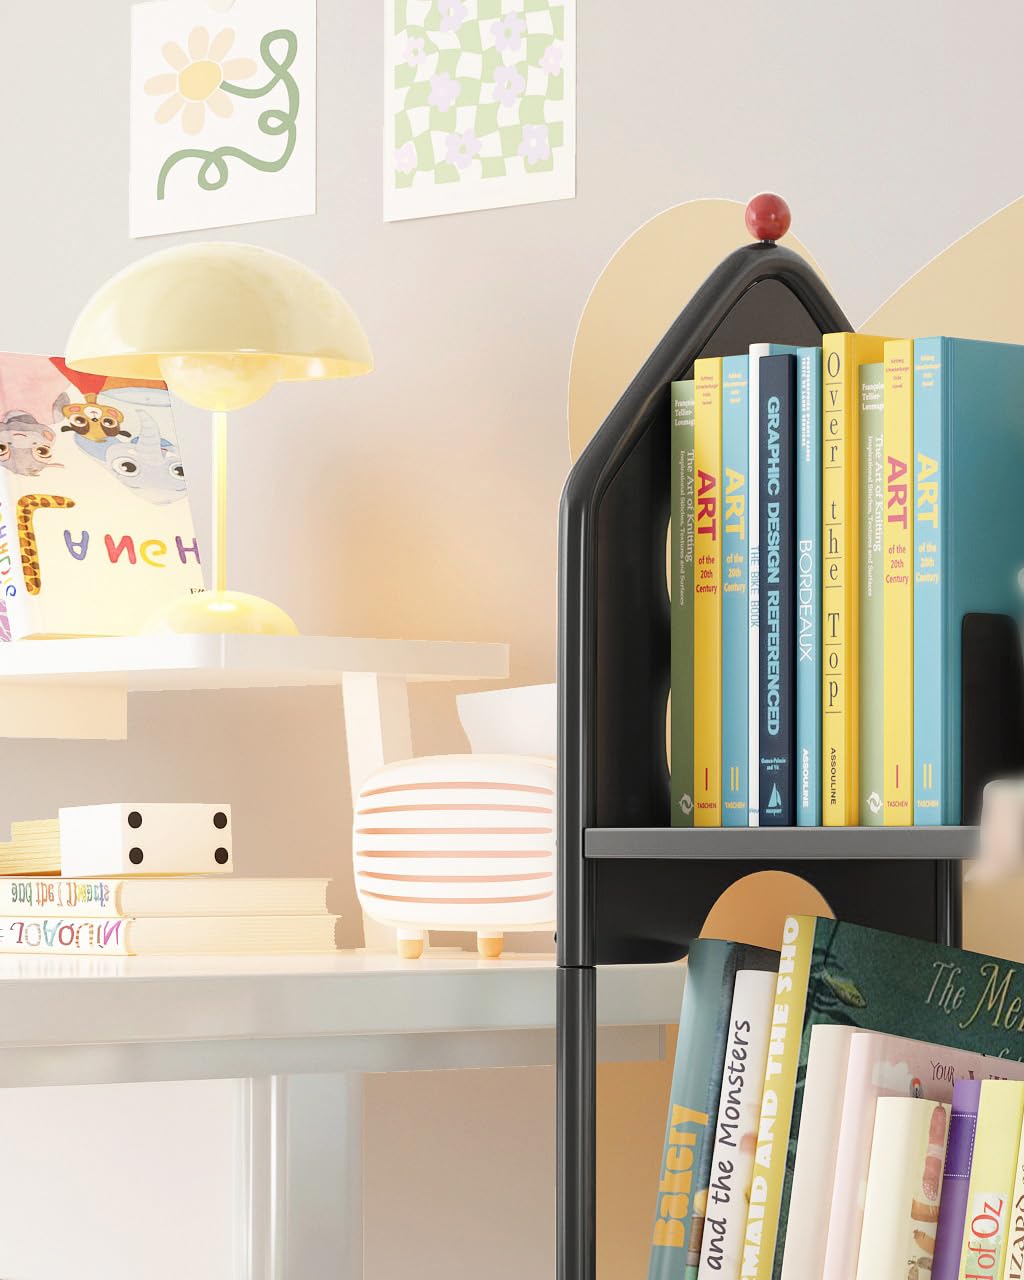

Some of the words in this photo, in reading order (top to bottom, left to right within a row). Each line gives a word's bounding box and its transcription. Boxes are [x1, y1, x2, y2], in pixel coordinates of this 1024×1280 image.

[827, 351, 840, 463] Over
[687, 449, 695, 473] The
[767, 396, 780, 497] GRAPHIC
[875, 434, 884, 459] The
[687, 476, 695, 495] Art
[875, 462, 884, 482] Art
[875, 485, 884, 498] of
[887, 456, 908, 530] ART
[917, 452, 939, 528] ART
[687, 498, 695, 510] of
[697, 469, 717, 542] ART
[725, 467, 745, 541] ART
[685, 514, 695, 563] Knitting
[767, 502, 780, 584] DESIGN
[828, 500, 839, 581] the
[873, 501, 884, 552] Knitting
[918, 542, 925, 553] of
[926, 542, 937, 553] the
[698, 555, 706, 566] of
[706, 555, 716, 566] the
[726, 553, 733, 564] of
[733, 553, 744, 564] the
[888, 544, 895, 555] of
[896, 544, 906, 555] the
[890, 558, 904, 569] 20th
[920, 556, 935, 568] 20th
[696, 583, 718, 595] Century
[700, 569, 714, 579] 20th
[723, 581, 746, 593] Century
[728, 567, 742, 578] 20th
[885, 573, 909, 585] Century
[915, 571, 939, 584] Century
[799, 540, 813, 662] BORDEAUX
[767, 590, 780, 736] REFERENCED
[828, 612, 840, 707] Top
[887, 800, 908, 808] TASCHEN
[777, 917, 799, 995] SHO
[925, 961, 966, 1014] The
[765, 1003, 789, 1080] THE
[719, 1020, 751, 1147] Monsters
[754, 1089, 778, 1169] AND
[653, 1103, 709, 1248] Bakery
[711, 1160, 734, 1205] the
[971, 1199, 1004, 1239] Oz
[707, 1217, 727, 1270] and
[967, 1241, 996, 1270] of
